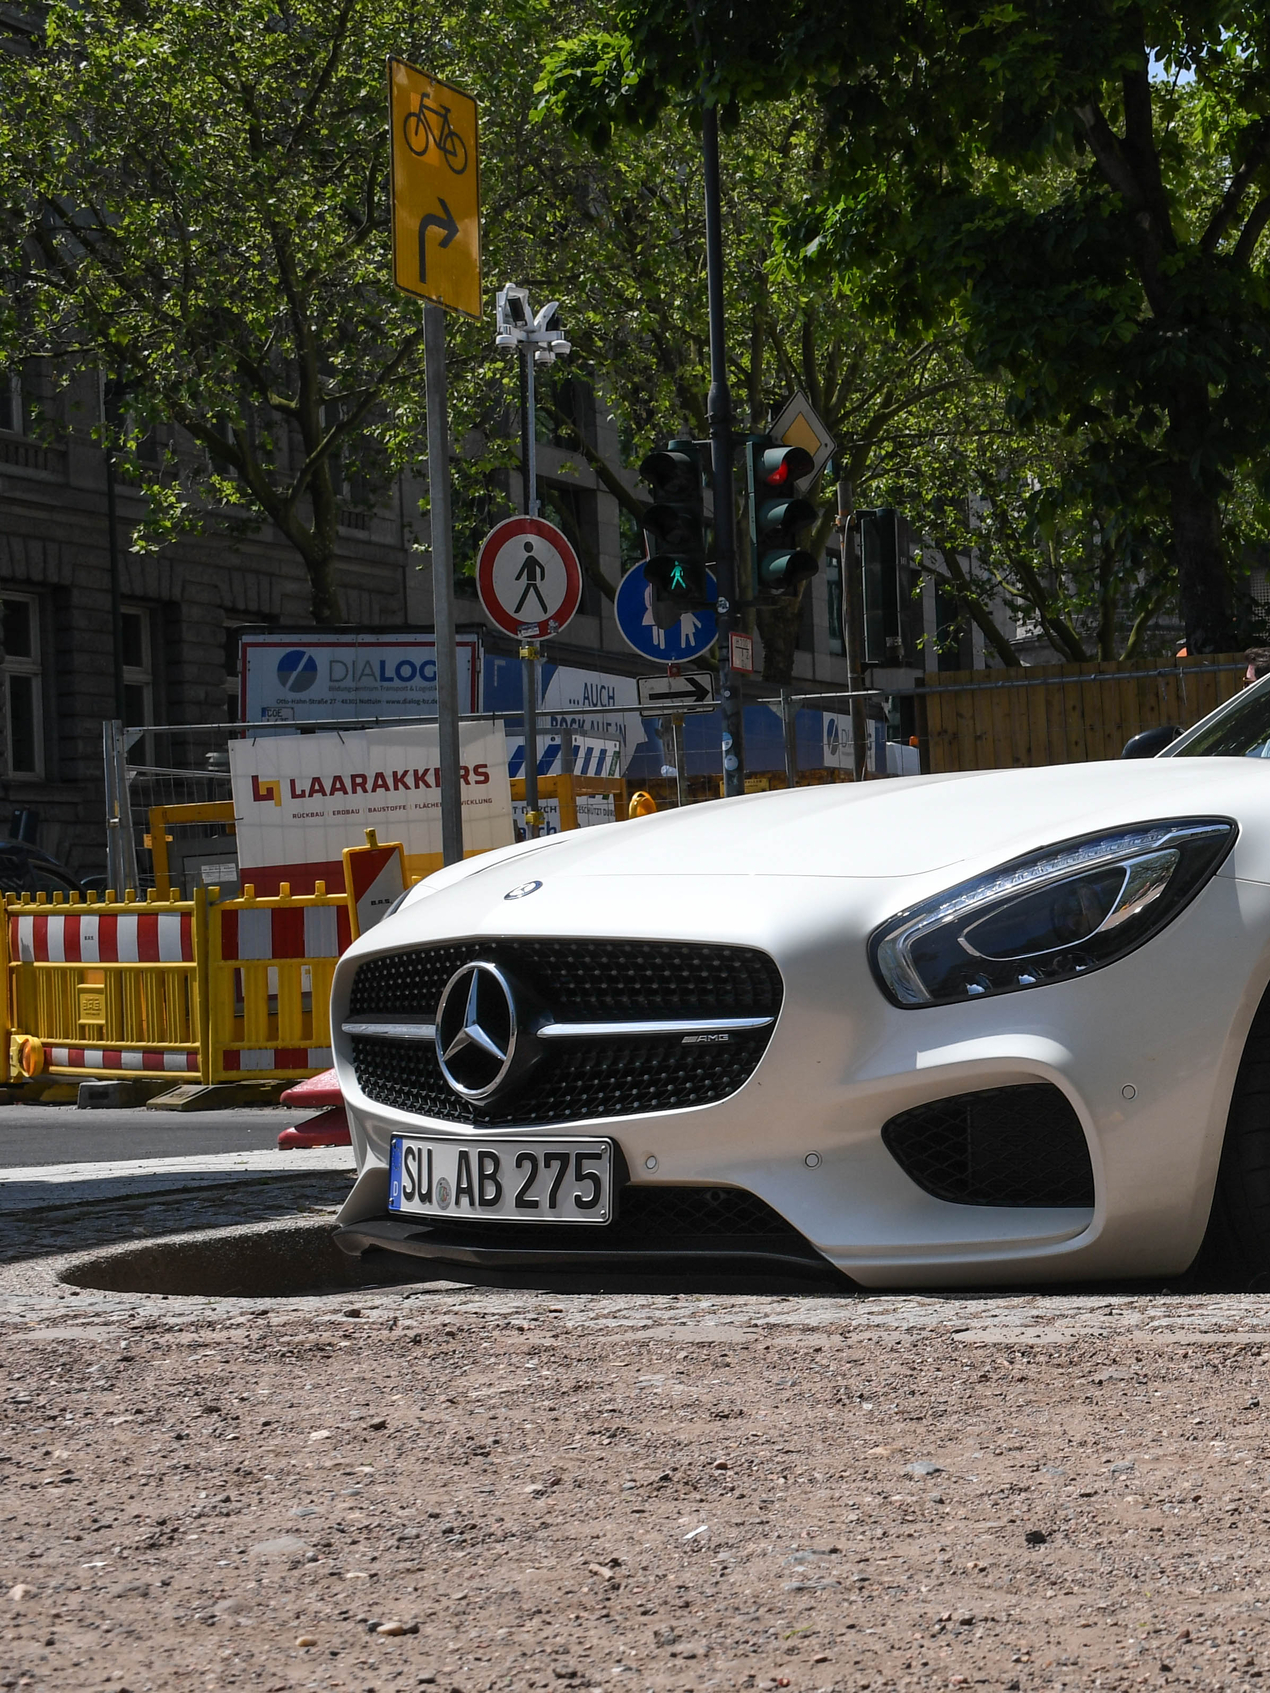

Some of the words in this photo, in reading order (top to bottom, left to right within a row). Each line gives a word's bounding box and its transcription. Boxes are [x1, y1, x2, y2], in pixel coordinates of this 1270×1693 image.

[329, 659, 437, 683] DIALOG
[328, 685, 379, 695] Bildungszentrum
[380, 685, 408, 694] Transport
[582, 682, 616, 707] AUCH
[292, 811, 324, 819] RÜCKBAU
[332, 808, 360, 816] ERDBAU
[368, 802, 407, 813] BAUSTOFFE
[696, 1034, 729, 1042] AMG
[402, 1145, 433, 1204] SU
[455, 1148, 503, 1207] AB
[514, 1150, 603, 1211] 275
[393, 1181, 398, 1196] D
